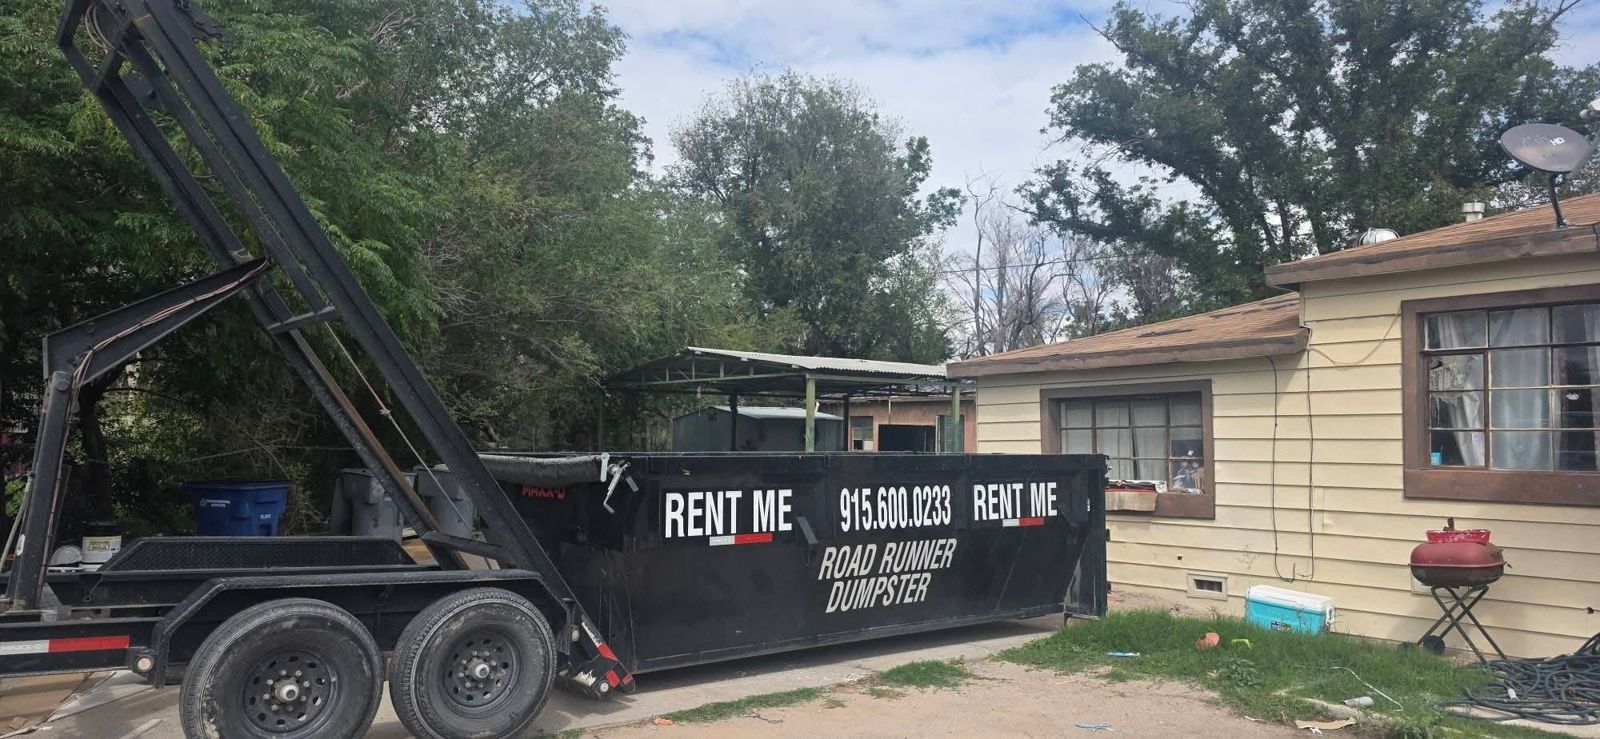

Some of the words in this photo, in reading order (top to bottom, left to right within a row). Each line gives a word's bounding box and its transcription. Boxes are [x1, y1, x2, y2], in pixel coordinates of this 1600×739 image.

[1550, 137, 1564, 146] HD
[665, 491, 743, 539] RENT
[752, 488, 793, 533] ME
[840, 484, 952, 533] 915.600.0233
[973, 483, 1024, 521] RENT
[1030, 482, 1058, 519] ME
[818, 544, 878, 581] ROAD
[879, 539, 958, 574] RUNNER
[825, 573, 932, 614] DUMPSTER
